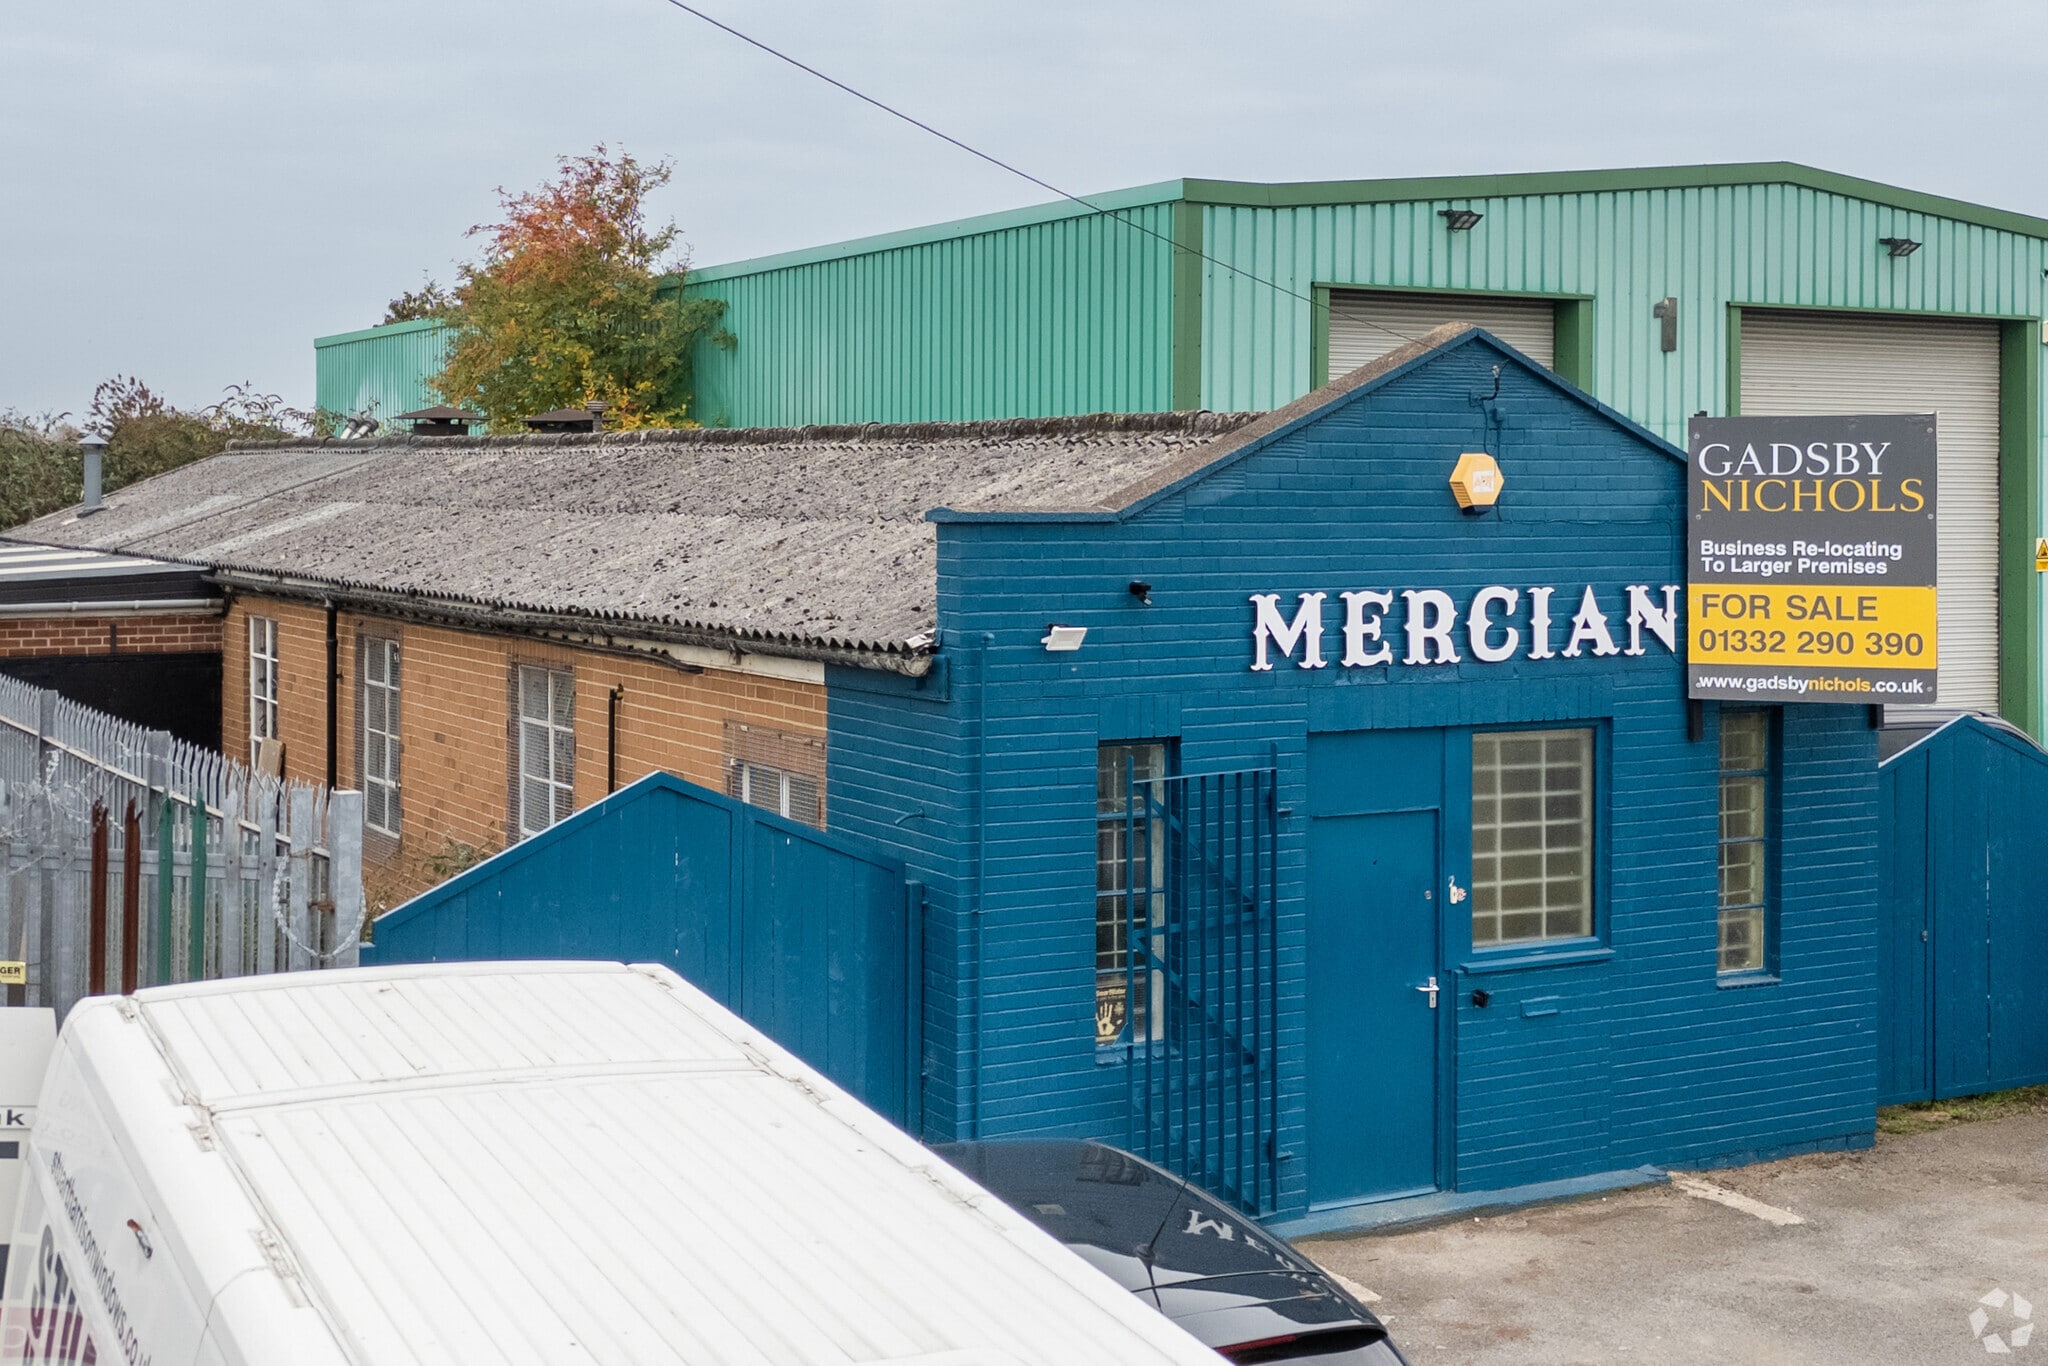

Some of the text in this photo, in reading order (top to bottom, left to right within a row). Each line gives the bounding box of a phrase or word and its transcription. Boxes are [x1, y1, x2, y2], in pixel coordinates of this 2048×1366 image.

[1699, 442, 1891, 476] GADSBY
[1700, 478, 1925, 512] NICHOLS
[1700, 540, 1902, 560] Business Re-locating
[1700, 557, 1887, 577] To Larger Premises
[1701, 593, 1878, 622] FOR SALE
[1249, 585, 1681, 671] MERCIAN
[1700, 629, 1923, 656] 01332 290 390
[1699, 675, 1923, 694] www.gadsbynichols.co.uk
